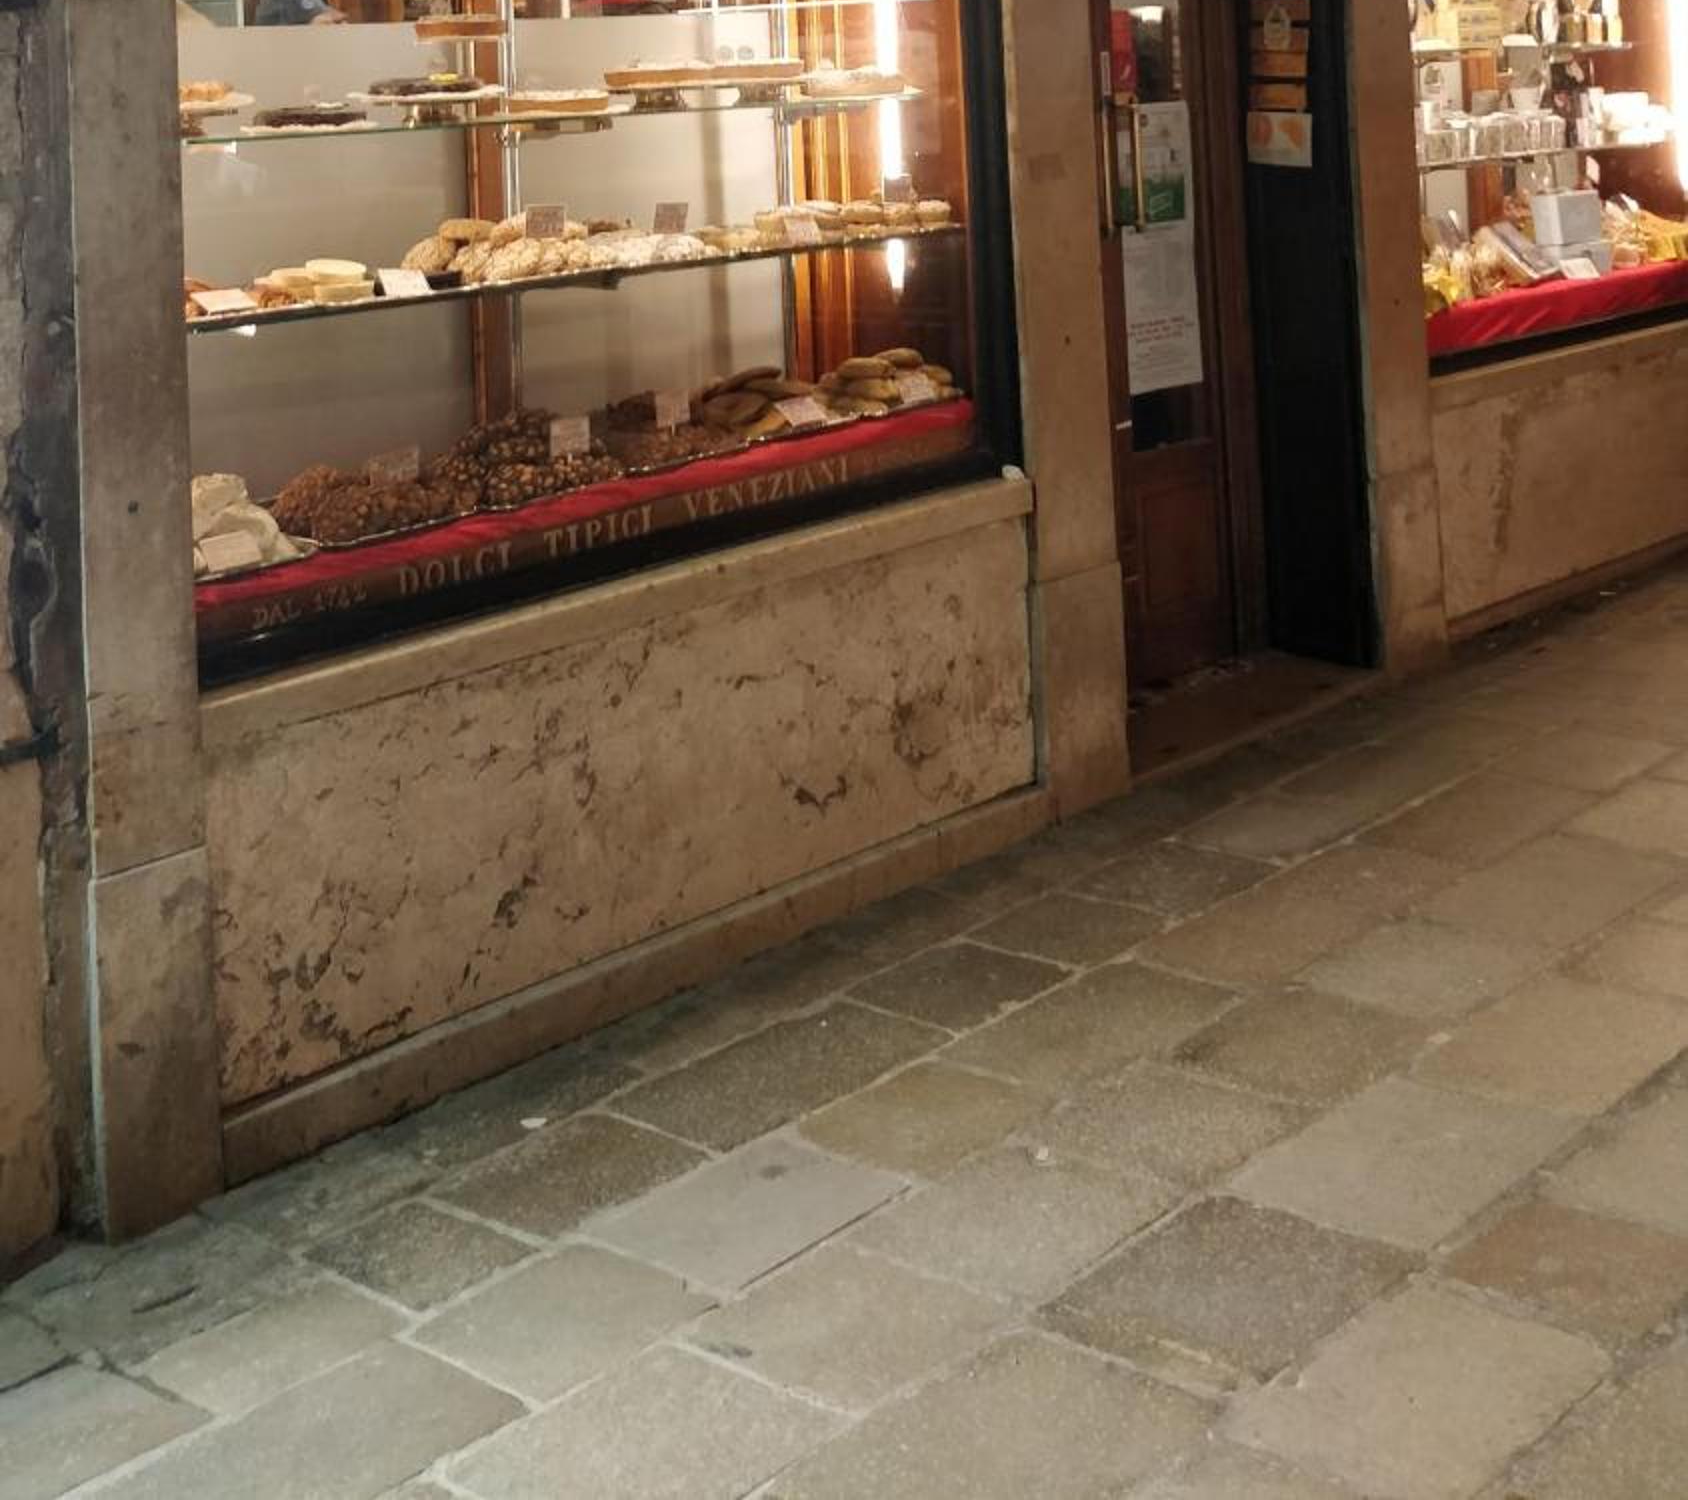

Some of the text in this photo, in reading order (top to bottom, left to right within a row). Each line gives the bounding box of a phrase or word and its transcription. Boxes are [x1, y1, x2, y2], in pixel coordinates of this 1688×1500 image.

[400, 541, 512, 596] DOLCI
[542, 503, 653, 558] TIPICI
[685, 454, 850, 521] VENEZIANI
